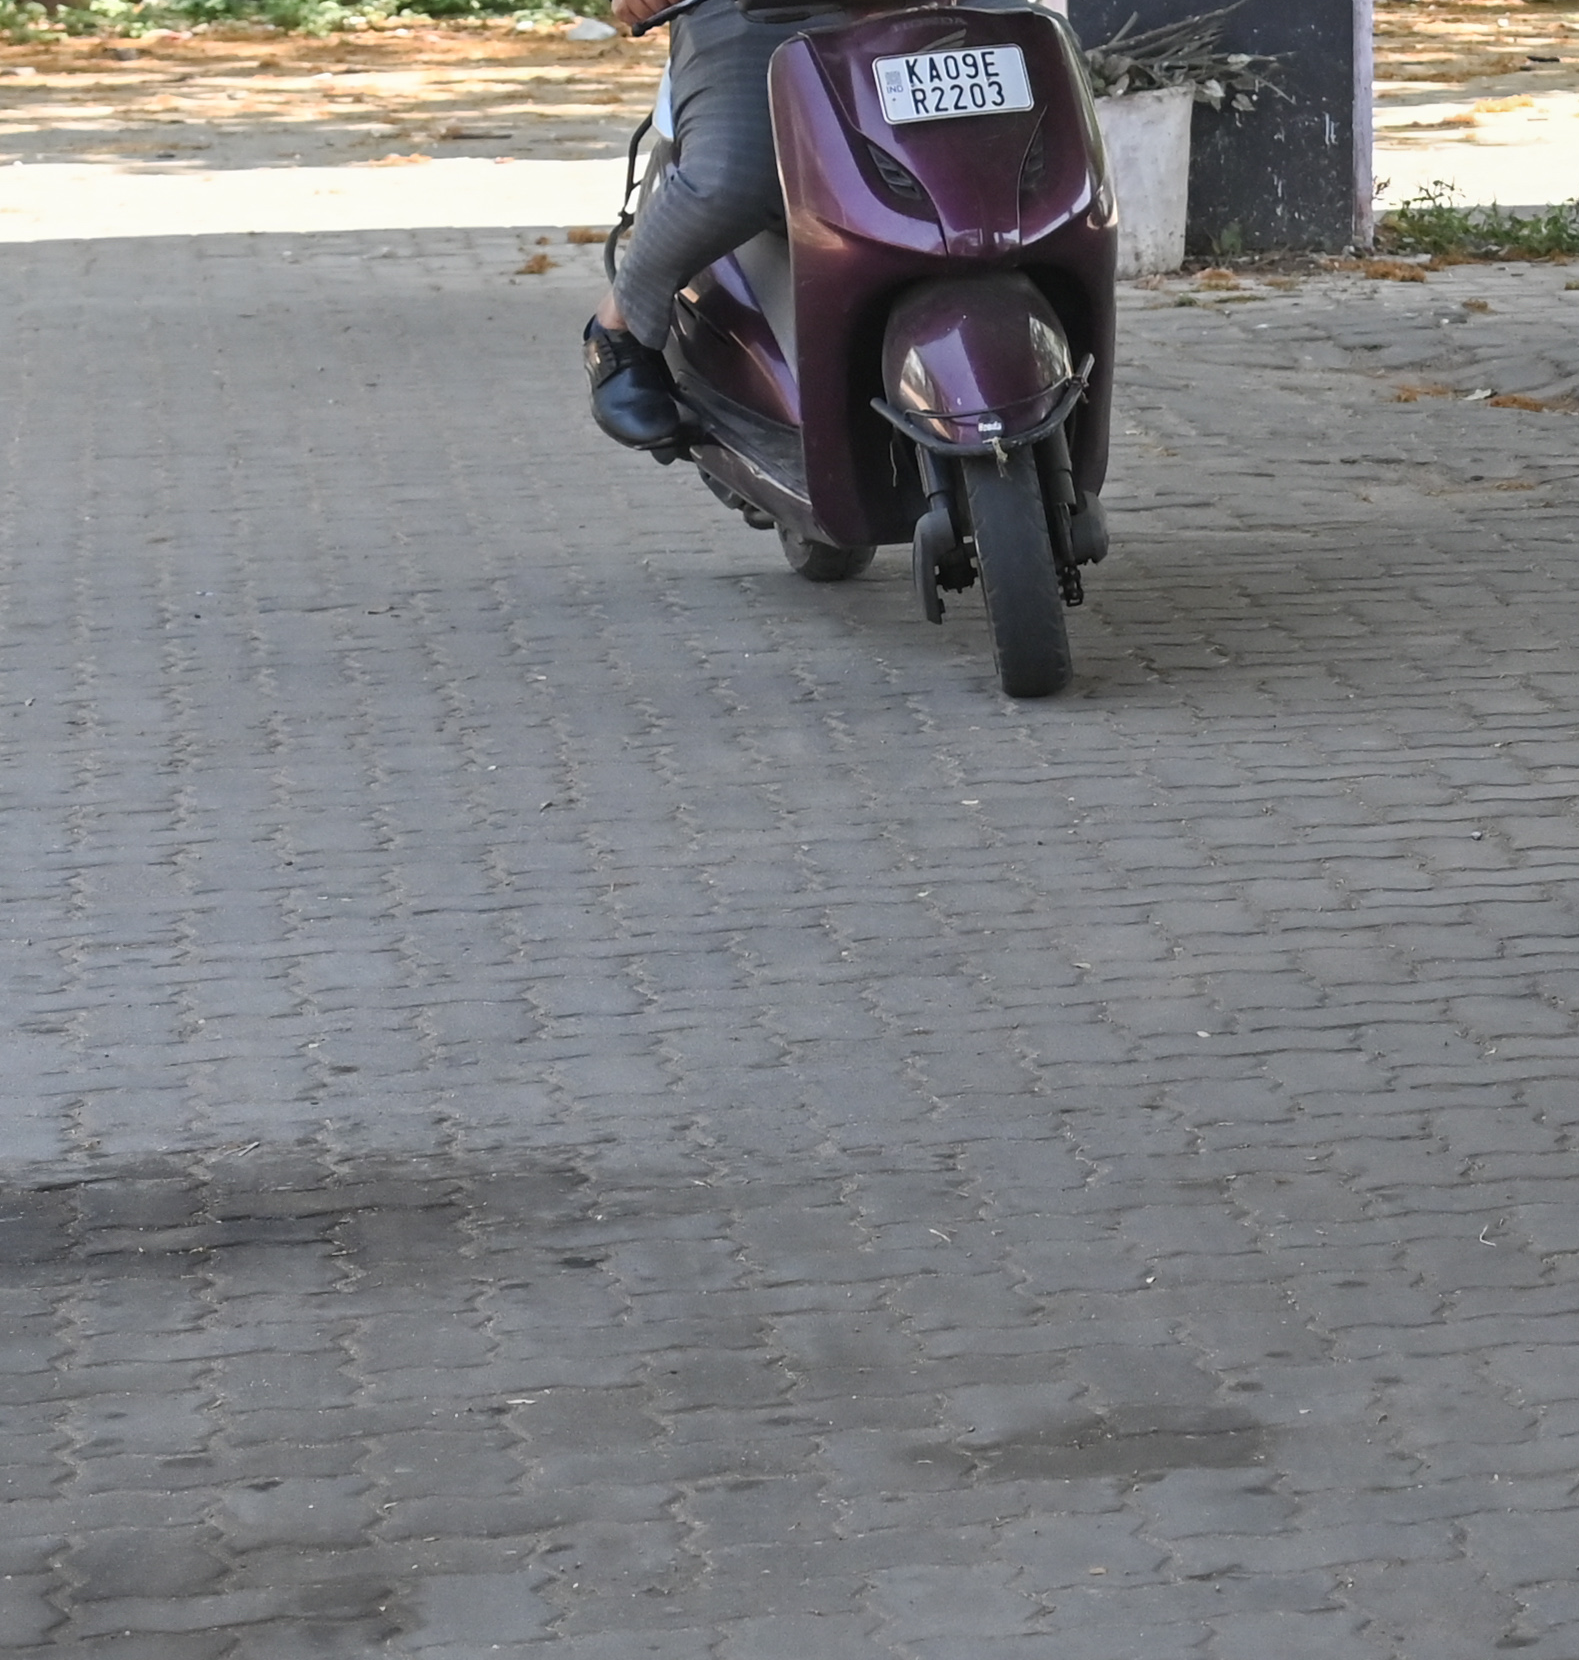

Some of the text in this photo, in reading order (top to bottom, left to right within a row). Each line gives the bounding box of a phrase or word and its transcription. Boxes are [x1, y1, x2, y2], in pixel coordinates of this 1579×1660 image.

[905, 51, 999, 85] KA09E
[887, 85, 903, 94] IND
[912, 81, 1005, 115] R2203
